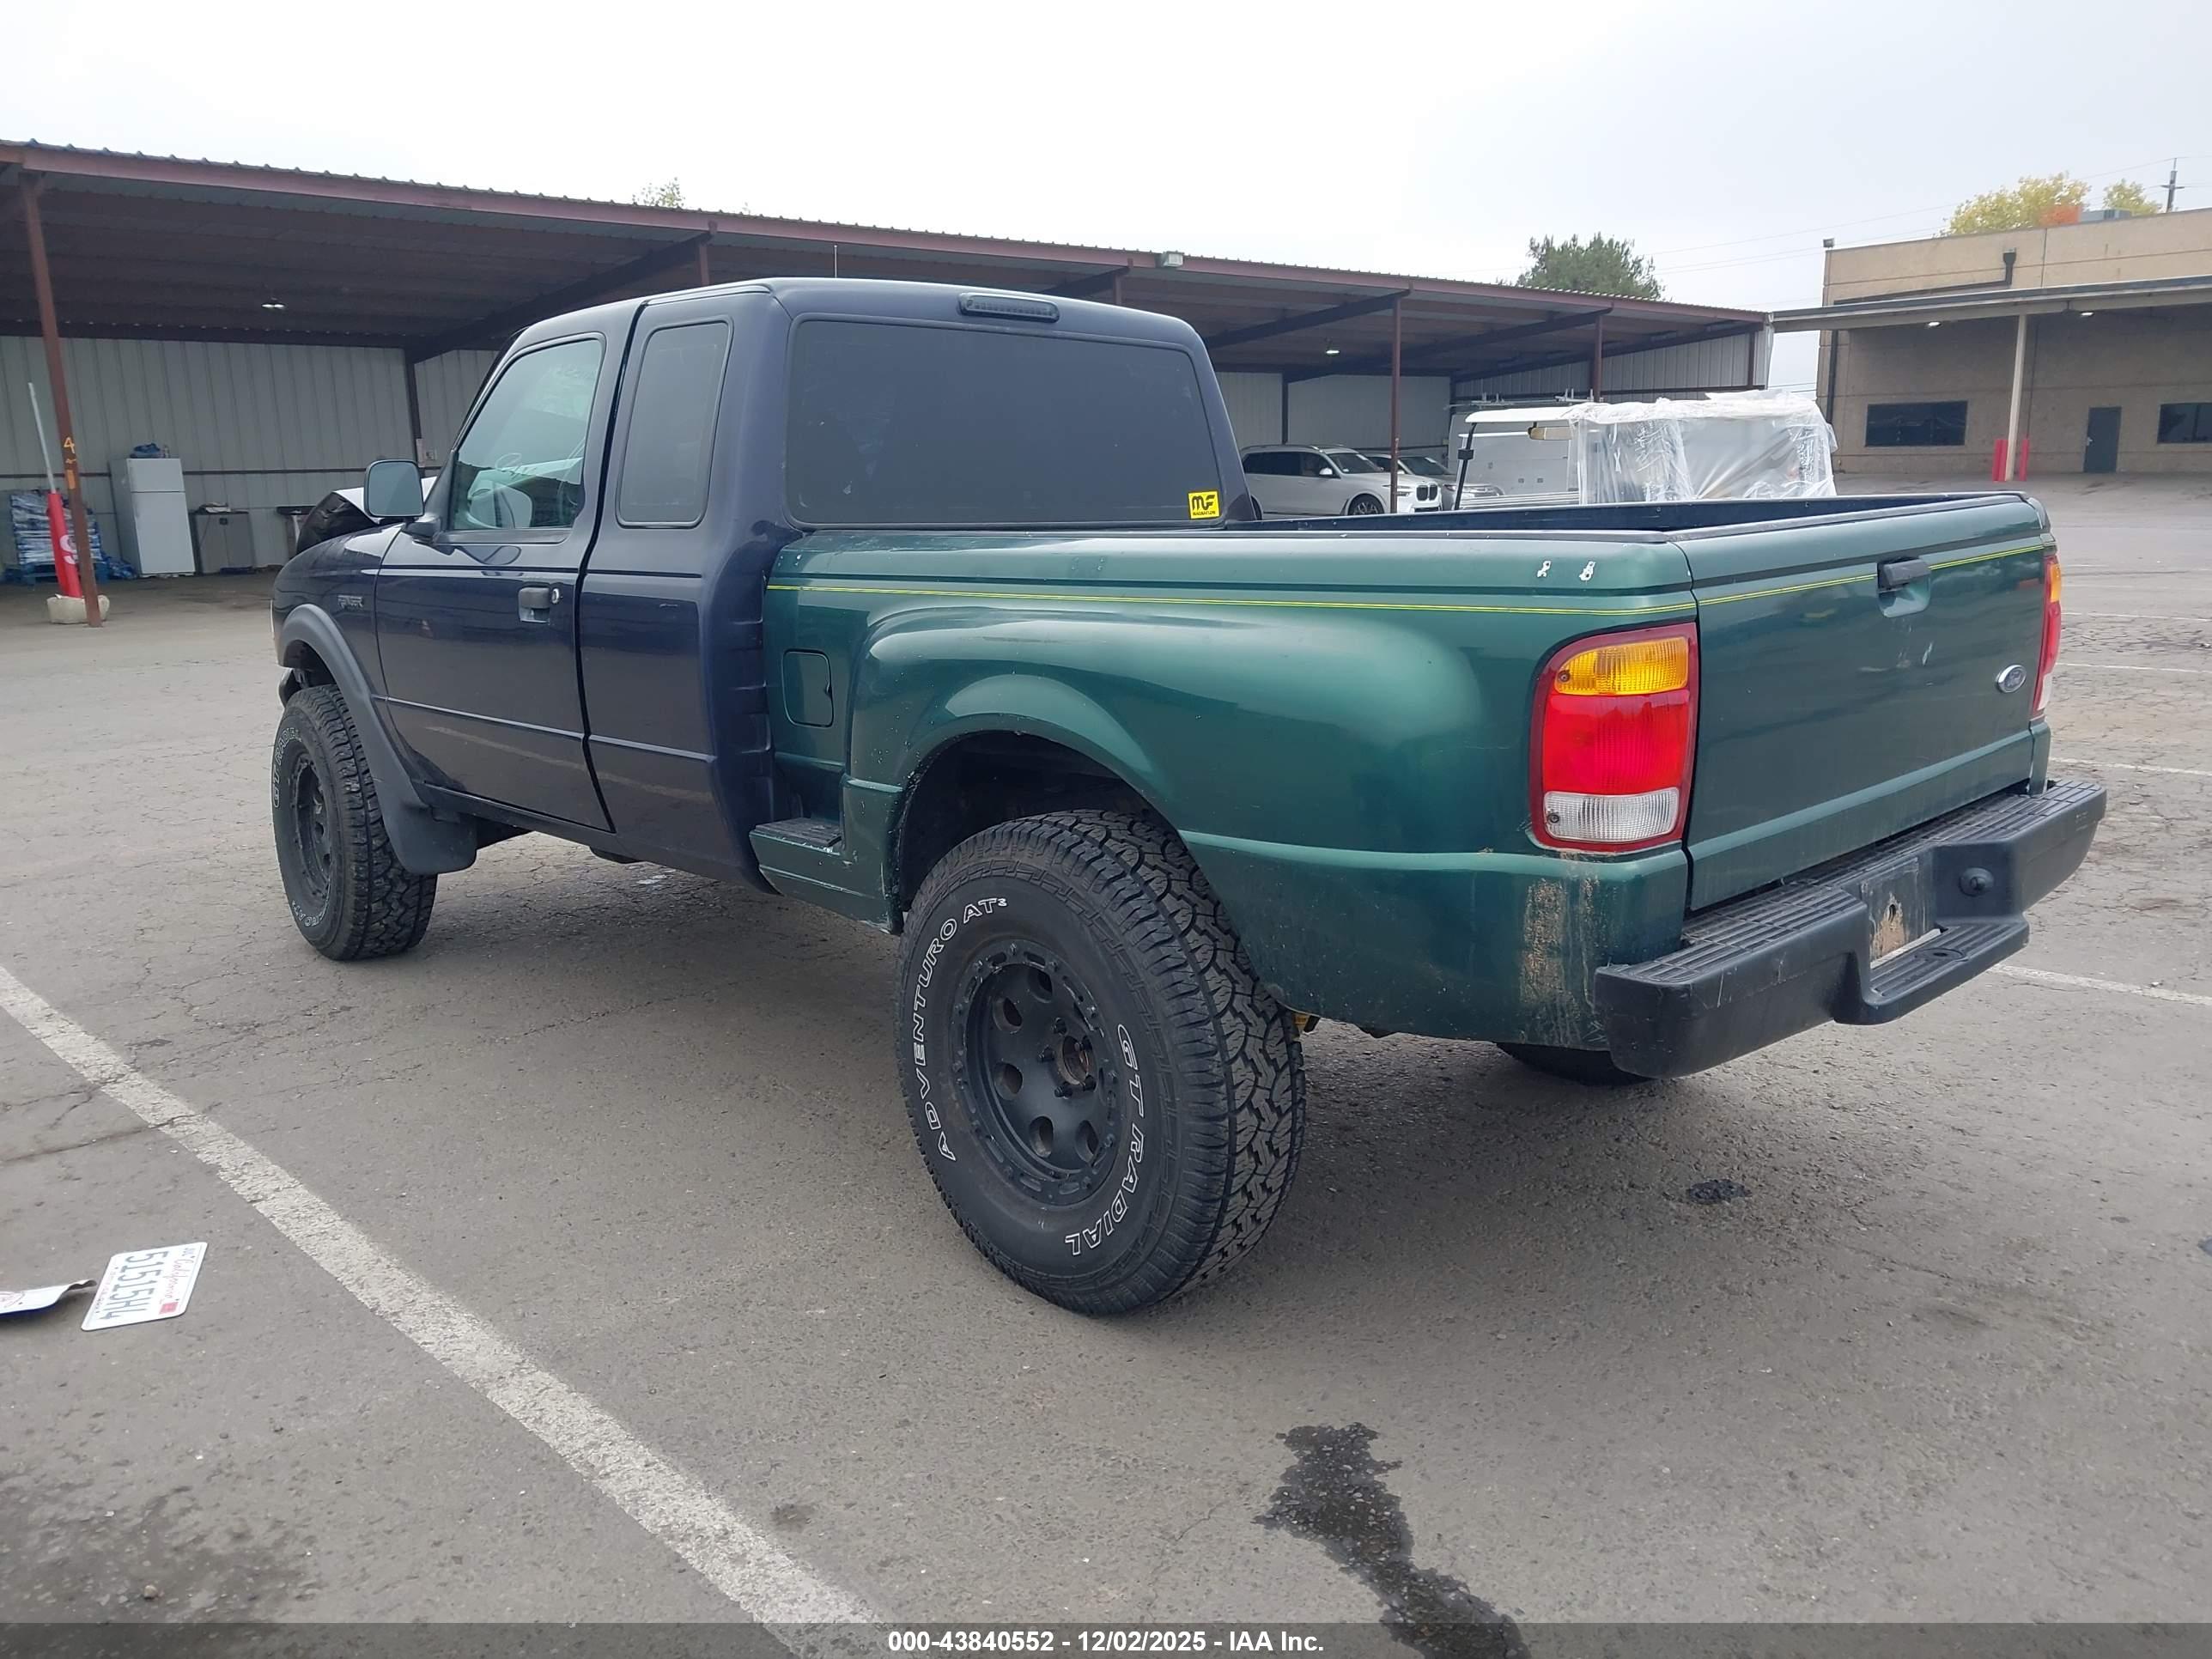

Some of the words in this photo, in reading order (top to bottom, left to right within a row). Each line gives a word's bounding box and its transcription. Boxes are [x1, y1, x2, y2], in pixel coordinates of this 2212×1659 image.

[63, 436, 76, 454] 4
[912, 918, 957, 1161] ADVENTURO
[1117, 1024, 1144, 1118] GT
[1065, 1122, 1145, 1255] RADIAL
